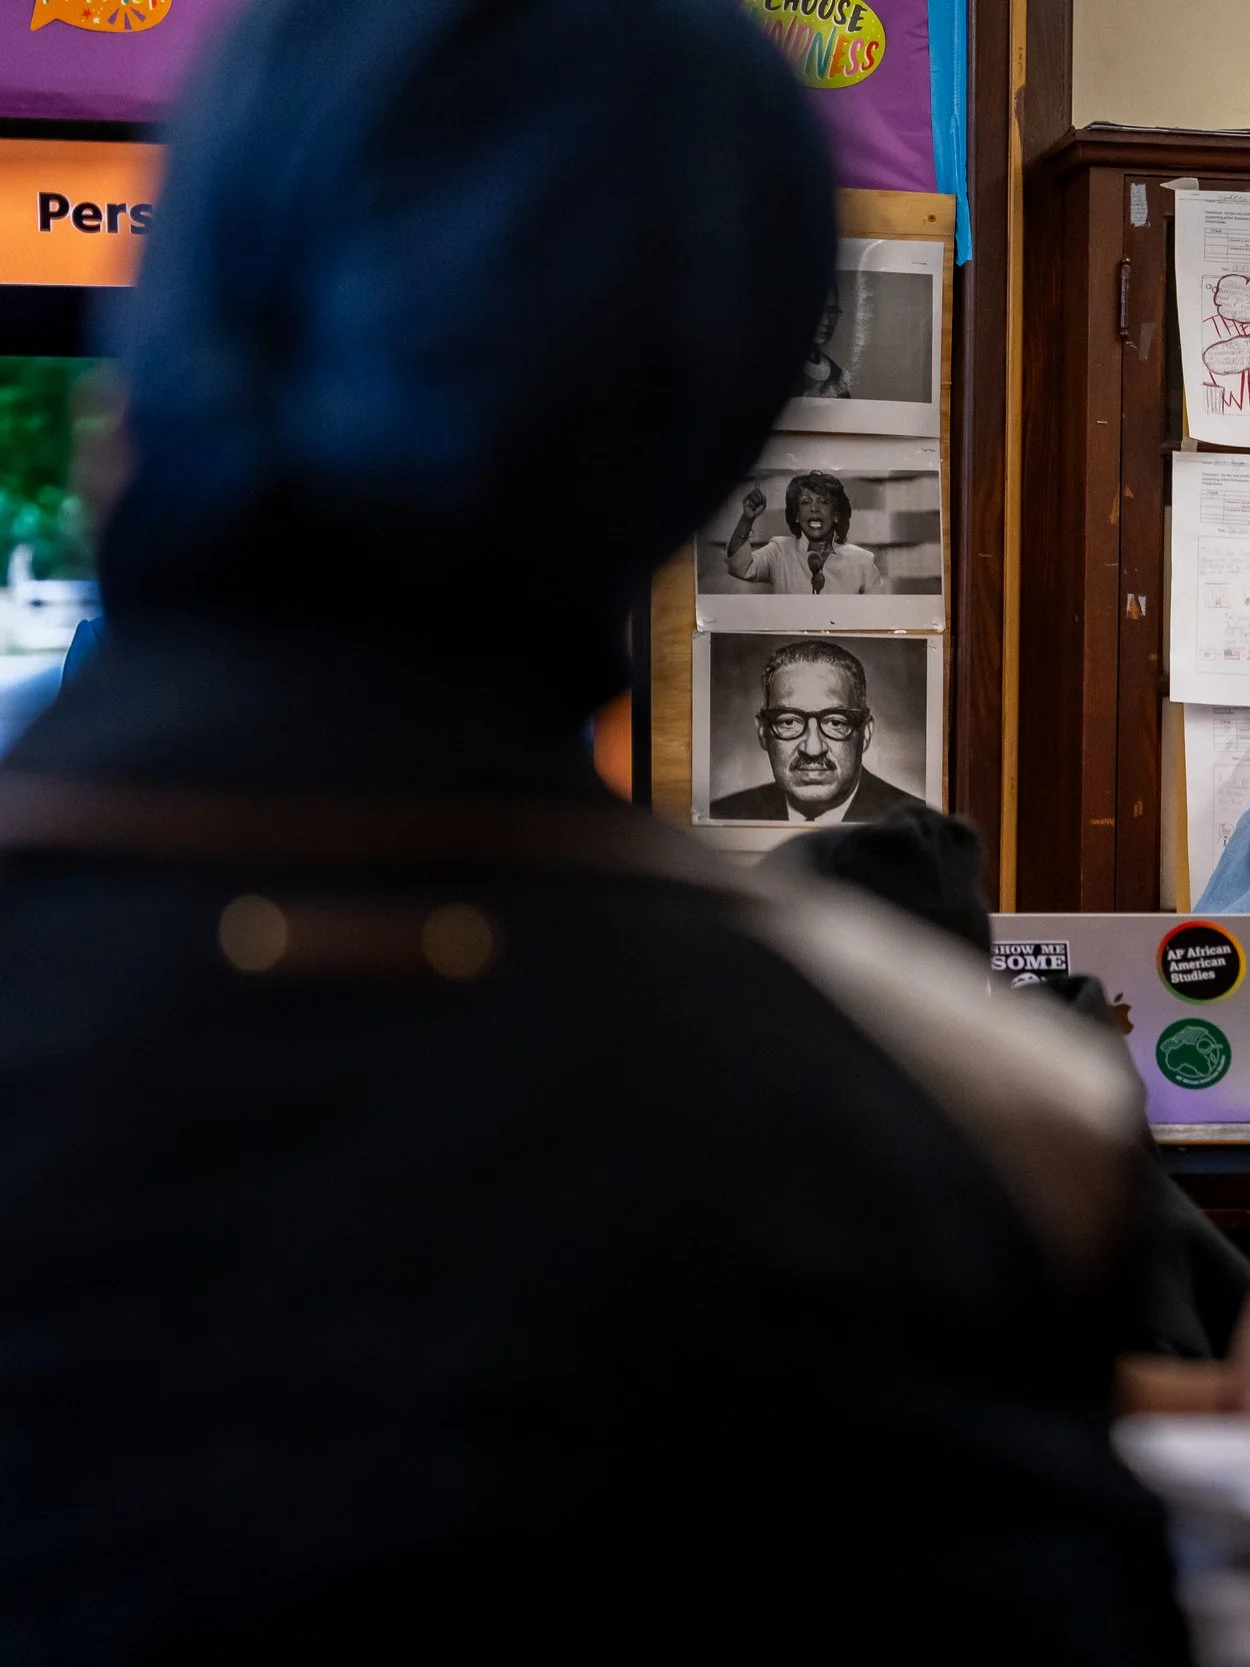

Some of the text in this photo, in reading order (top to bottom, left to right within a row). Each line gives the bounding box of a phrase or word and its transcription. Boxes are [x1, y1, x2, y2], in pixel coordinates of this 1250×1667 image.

[990, 944, 1066, 955] SHOW ME
[1167, 945, 1232, 961] AP African
[990, 955, 1067, 971] SOME
[1169, 957, 1227, 972] American
[1170, 970, 1216, 984] Studies
